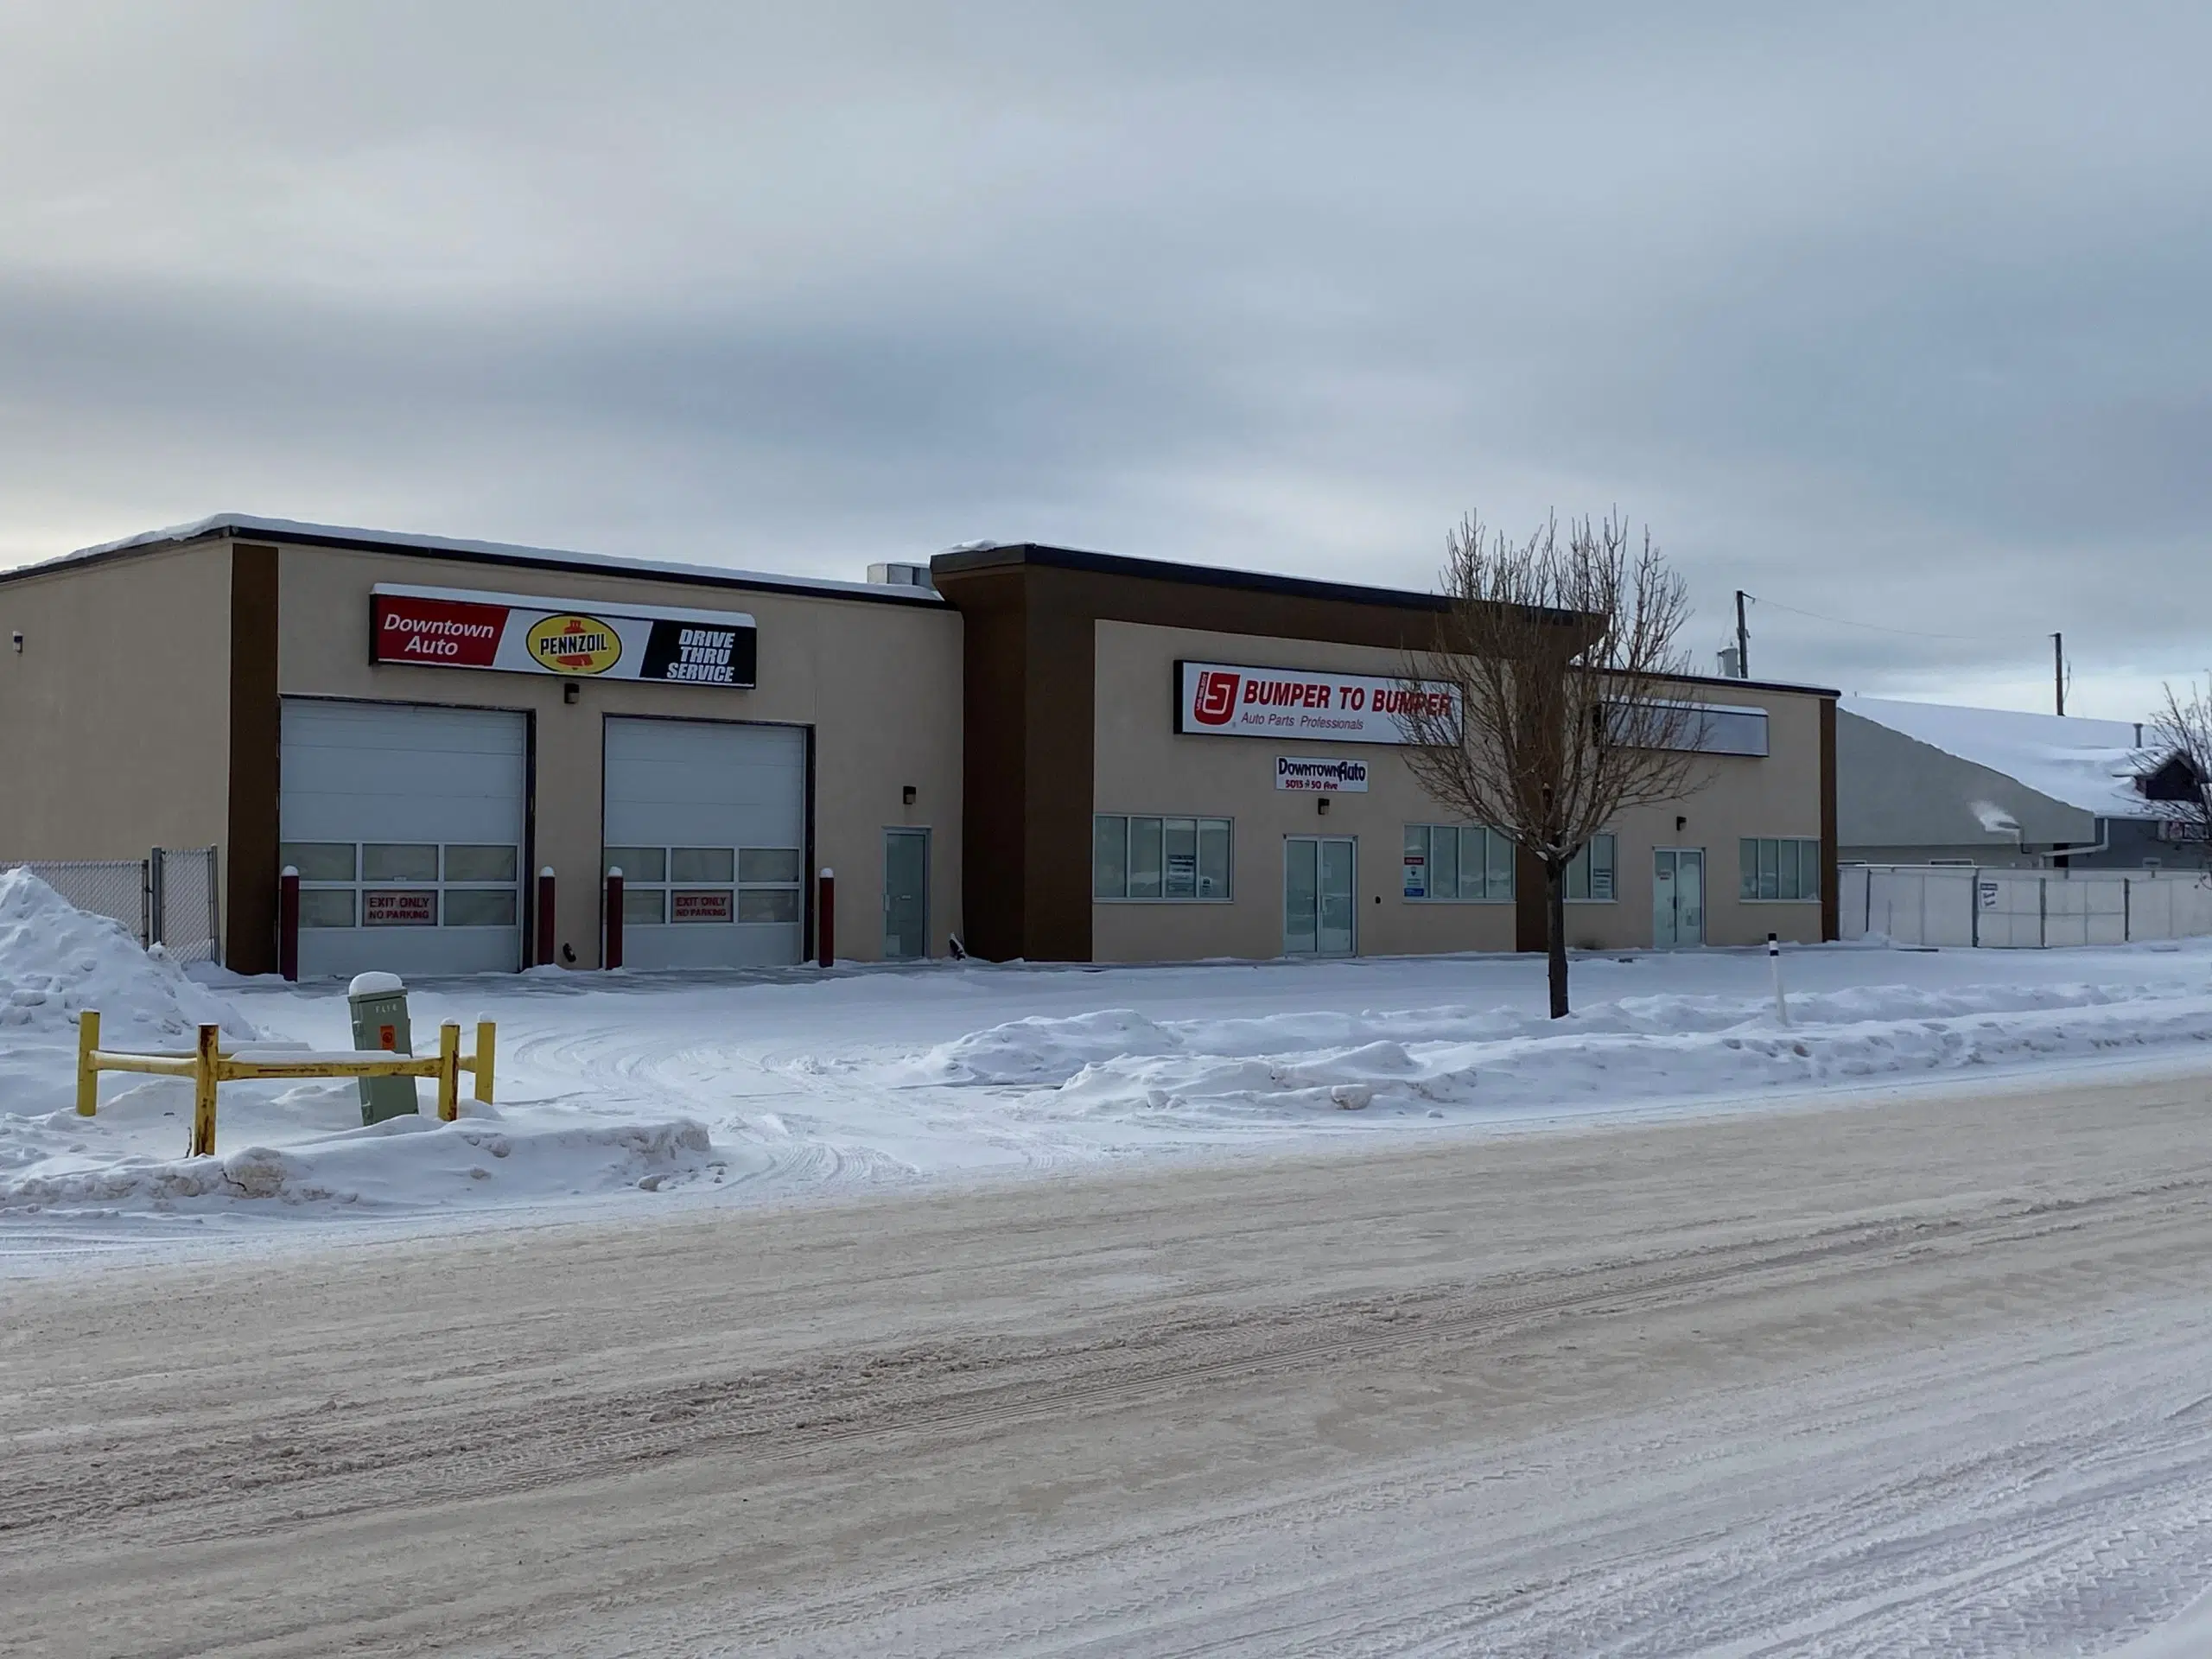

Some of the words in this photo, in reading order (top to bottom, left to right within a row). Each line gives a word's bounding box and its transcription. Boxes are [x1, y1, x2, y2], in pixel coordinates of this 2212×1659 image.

[384, 613, 494, 639] Downtown
[404, 635, 459, 656] Auto
[540, 633, 608, 656] PENNZOIL
[679, 629, 735, 648] DRIVE
[680, 646, 731, 665] THRU
[666, 662, 735, 683] SERVICE
[1243, 680, 1332, 709] BUMPER
[1339, 686, 1365, 711] TO
[1372, 689, 1452, 716] BUMPER
[1241, 711, 1265, 725] Auto
[1268, 713, 1295, 727] Parts
[1300, 715, 1363, 730] Professionals
[1311, 780, 1322, 789] 50
[1324, 781, 1338, 790] Ave
[369, 897, 396, 908] EXIT
[399, 897, 430, 908] ONLY
[677, 897, 699, 906] EXIT
[701, 897, 727, 906] ONLY
[369, 910, 384, 919] NO
[386, 910, 429, 919] PARKING
[677, 908, 690, 917] NO
[690, 908, 727, 917] PARKING
